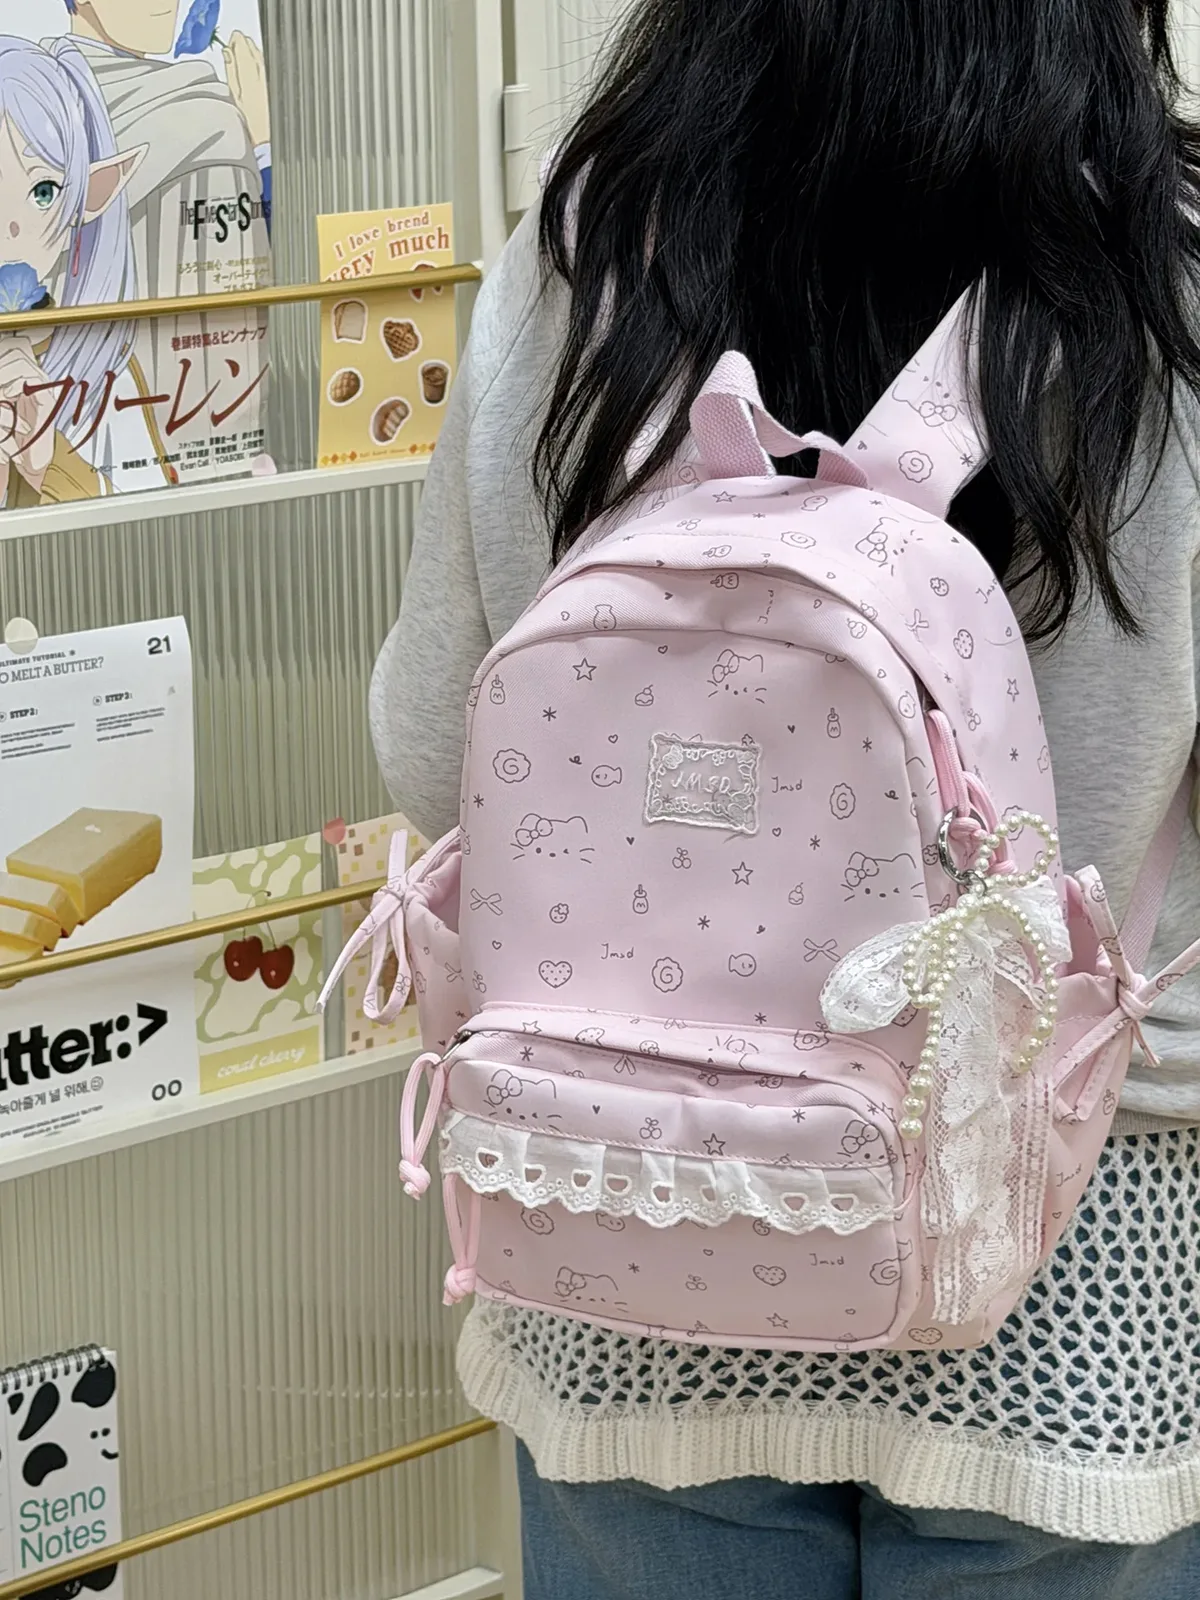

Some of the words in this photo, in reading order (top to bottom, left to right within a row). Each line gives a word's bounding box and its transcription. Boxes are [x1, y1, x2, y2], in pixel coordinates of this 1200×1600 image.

[349, 228, 380, 250] love
[388, 226, 449, 258] much
[147, 634, 172, 656] 21
[11, 666, 42, 682] MELT
[53, 656, 105, 676] BUTTER?
[19, 1486, 106, 1533] Steno
[20, 1519, 107, 1569] Notes
